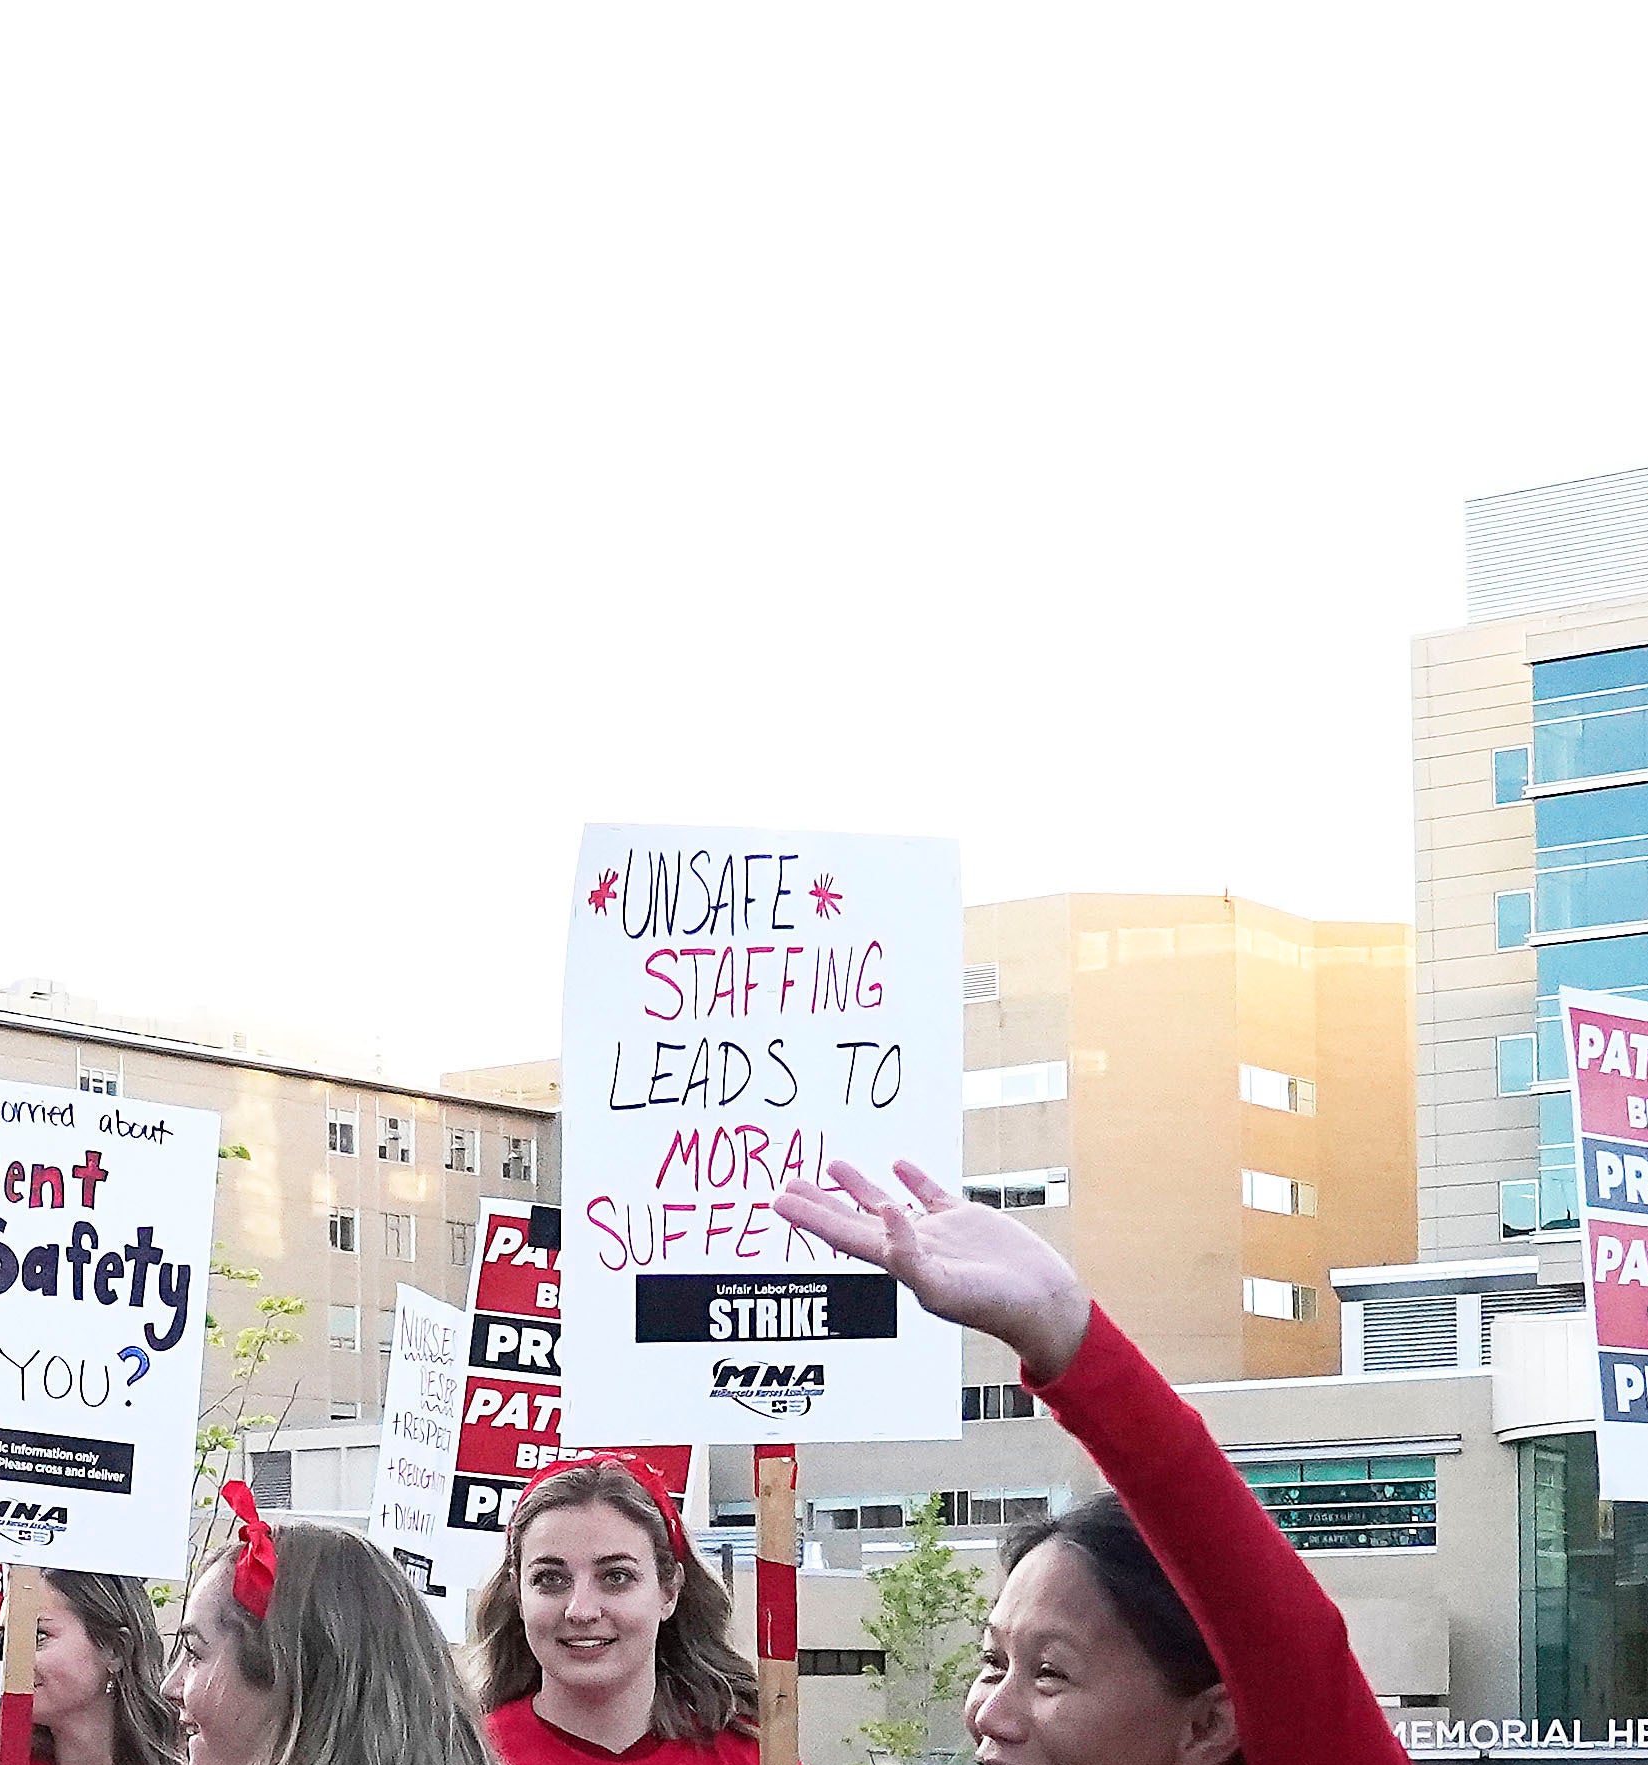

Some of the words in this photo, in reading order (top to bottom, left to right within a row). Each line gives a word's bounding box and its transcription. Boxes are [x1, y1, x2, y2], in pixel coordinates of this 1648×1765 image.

[644, 941, 885, 1021] STAFFING
[610, 1040, 799, 1110] LEADS
[837, 1043, 901, 1107] TO
[99, 1110, 174, 1144] about
[656, 1125, 846, 1191] MORAL
[587, 1196, 851, 1270] SUFFER
[716, 1284, 751, 1295] Unfair
[754, 1284, 786, 1295] Labor
[788, 1283, 828, 1294] Practice
[709, 1297, 829, 1339] STRIKE
[714, 1365, 825, 1387] MNA
[34, 1462, 63, 1476] cross
[64, 1466, 86, 1479] and
[87, 1469, 126, 1483] deliver
[74, 1449, 100, 1466] only
